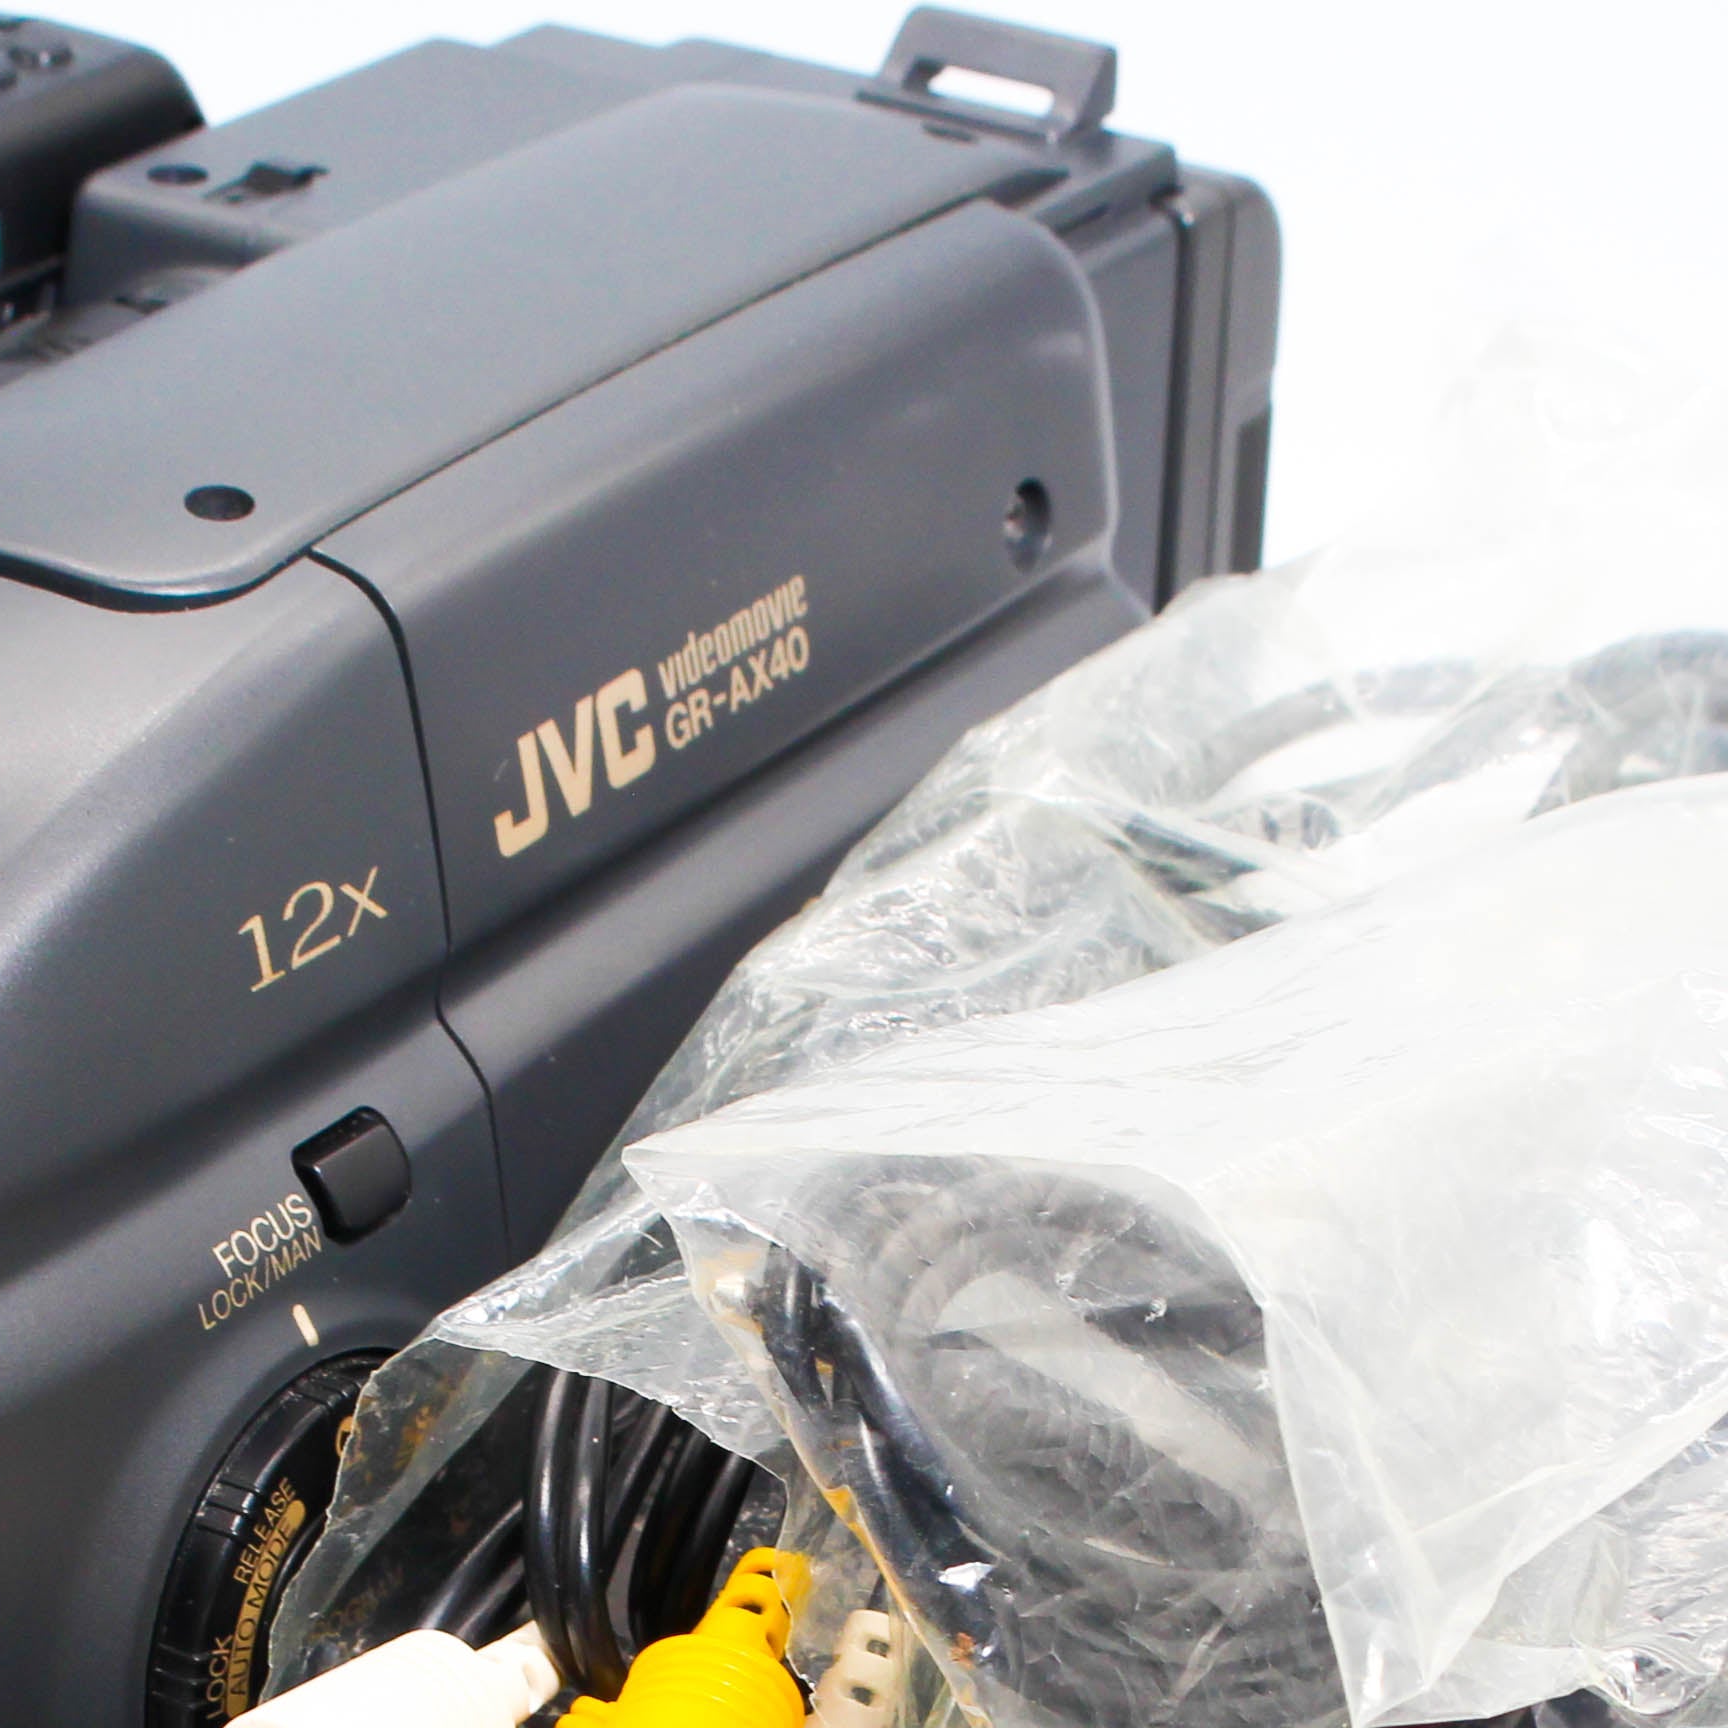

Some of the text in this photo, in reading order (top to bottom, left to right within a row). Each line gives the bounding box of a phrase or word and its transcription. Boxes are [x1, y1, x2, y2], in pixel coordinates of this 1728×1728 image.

[657, 574, 809, 699] videomovie
[664, 625, 810, 751] GR-AX40
[493, 667, 657, 859] JVC
[198, 1225, 322, 1331] LOCK/MAN
[212, 1193, 313, 1278] FOCUS
[233, 1476, 298, 1585] RELEASE
[229, 1523, 296, 1697] AUTO MODE
[206, 1633, 234, 1721] LOCK
